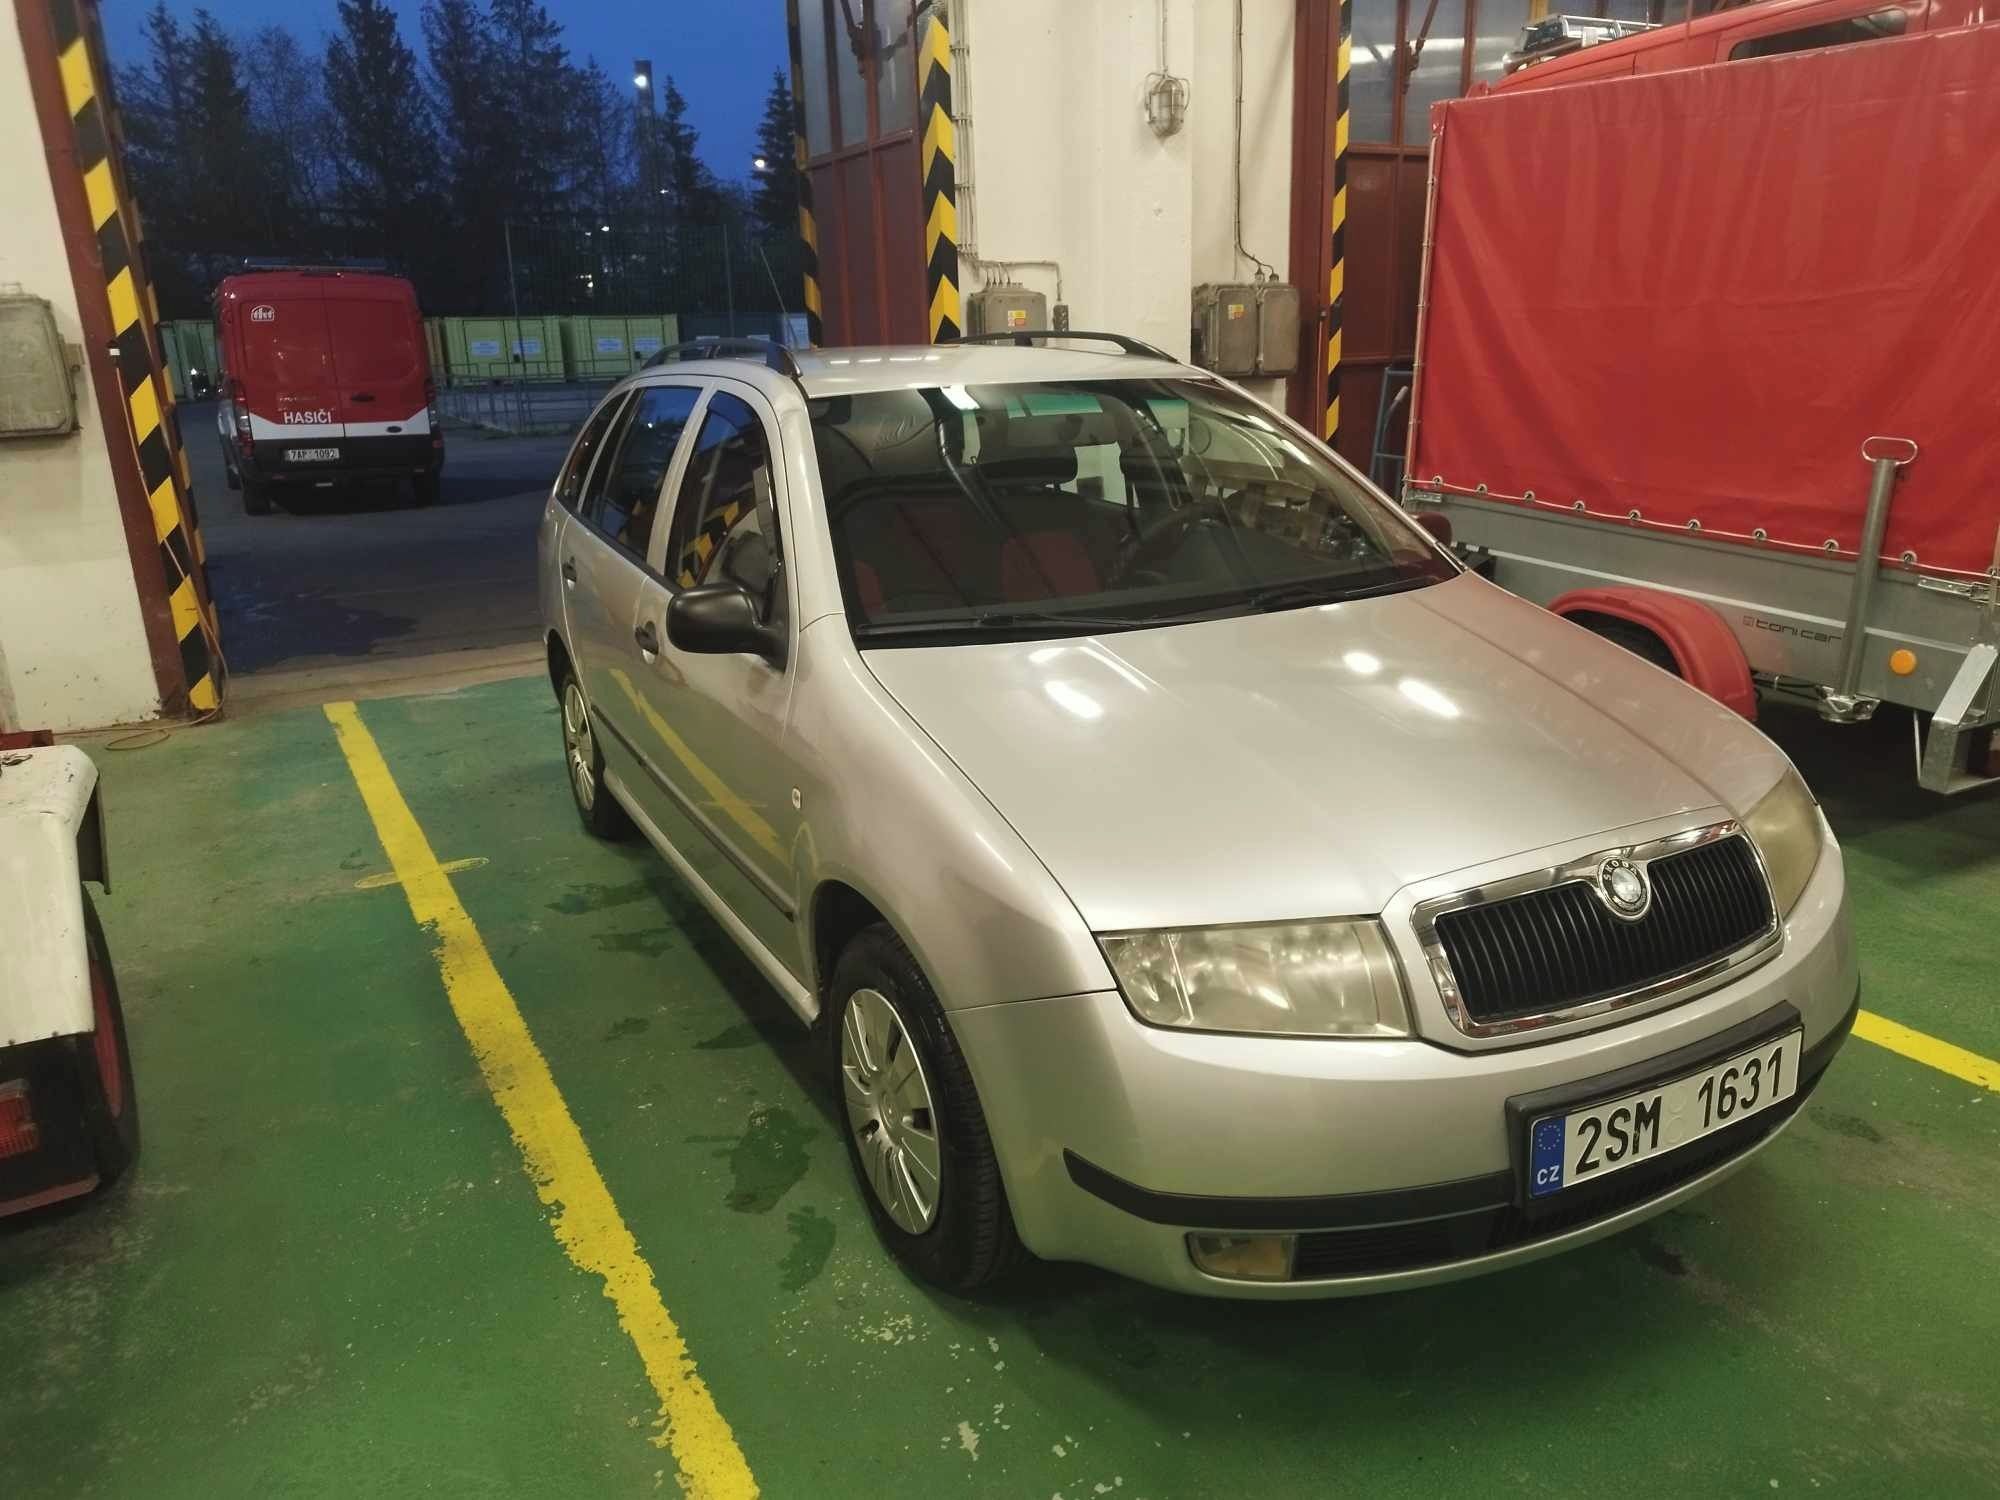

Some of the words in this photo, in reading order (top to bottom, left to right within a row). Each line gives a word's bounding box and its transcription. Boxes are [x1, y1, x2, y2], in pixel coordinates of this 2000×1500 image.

[284, 409, 331, 424] HASIČI
[1575, 1095, 1662, 1176] 2SM
[1697, 1046, 1784, 1129] 1631
[1537, 1165, 1560, 1186] CZ
